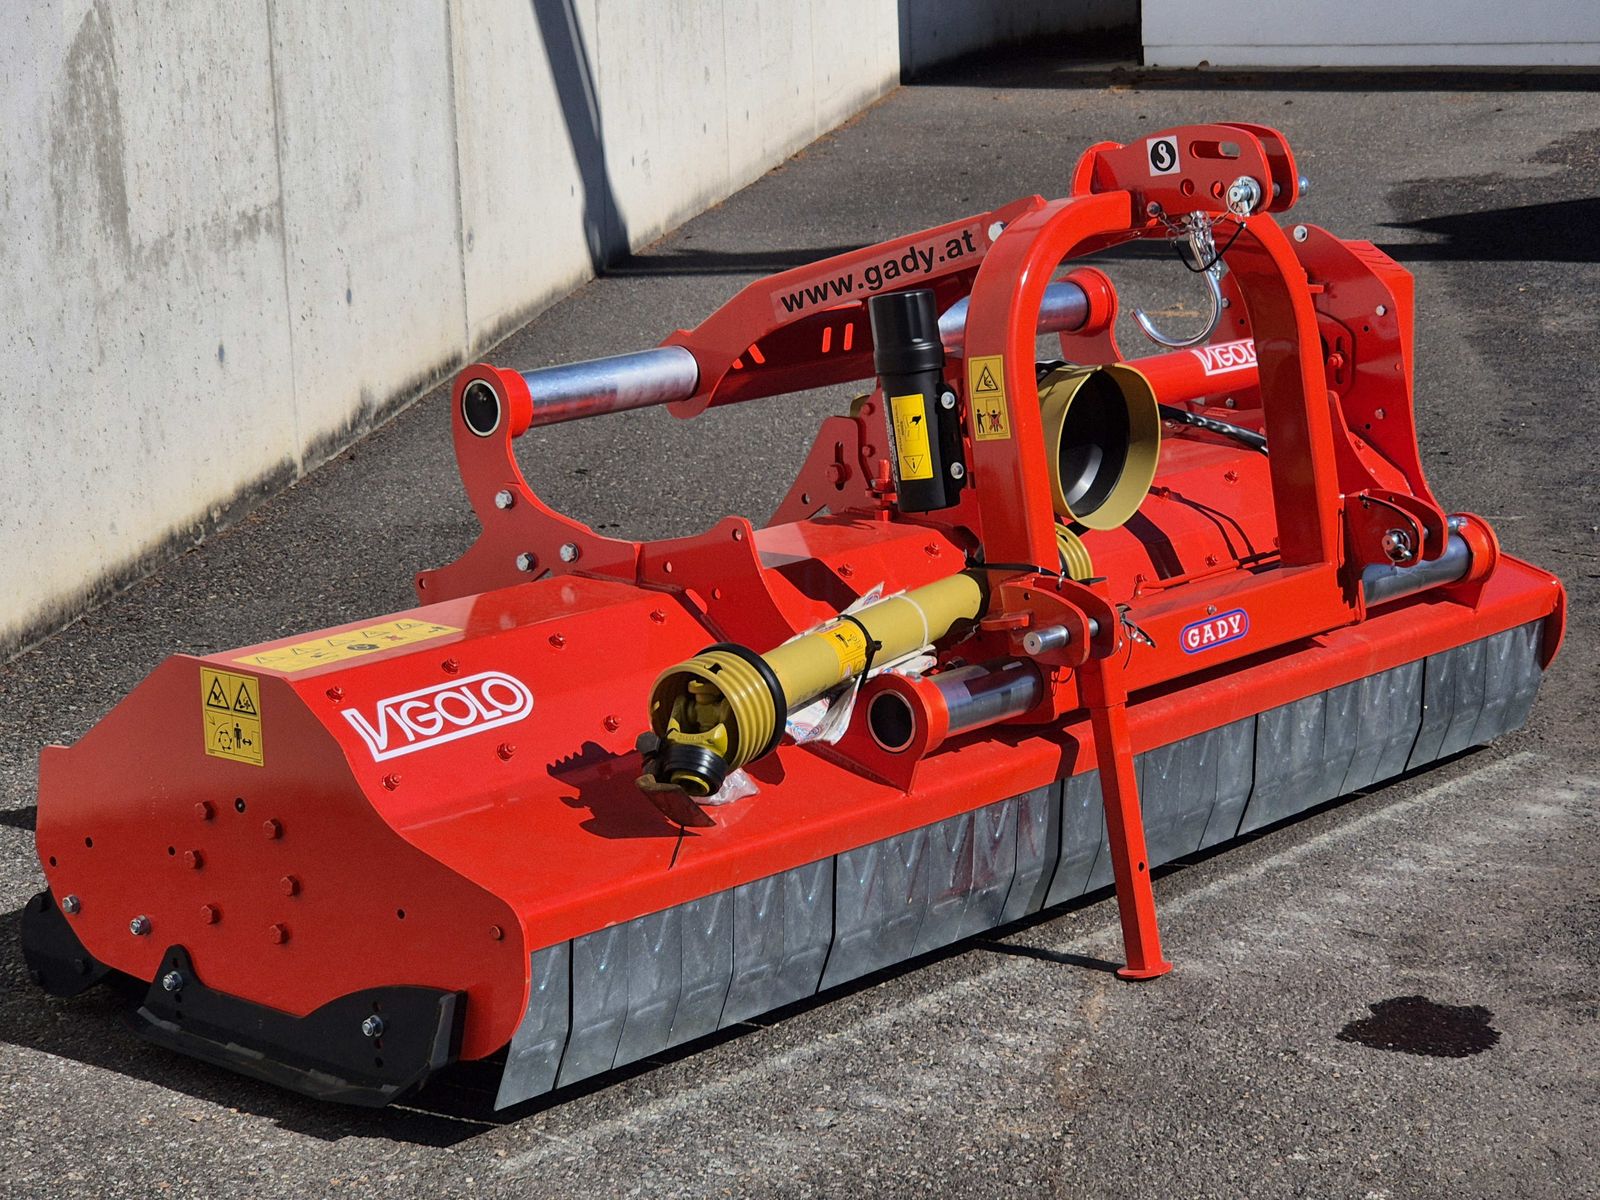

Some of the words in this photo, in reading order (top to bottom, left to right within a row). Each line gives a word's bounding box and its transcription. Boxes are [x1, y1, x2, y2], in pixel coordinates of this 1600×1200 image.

[781, 230, 976, 312] www.gady.at
[1187, 614, 1241, 648] GADY
[341, 672, 534, 762] VIGOLO
